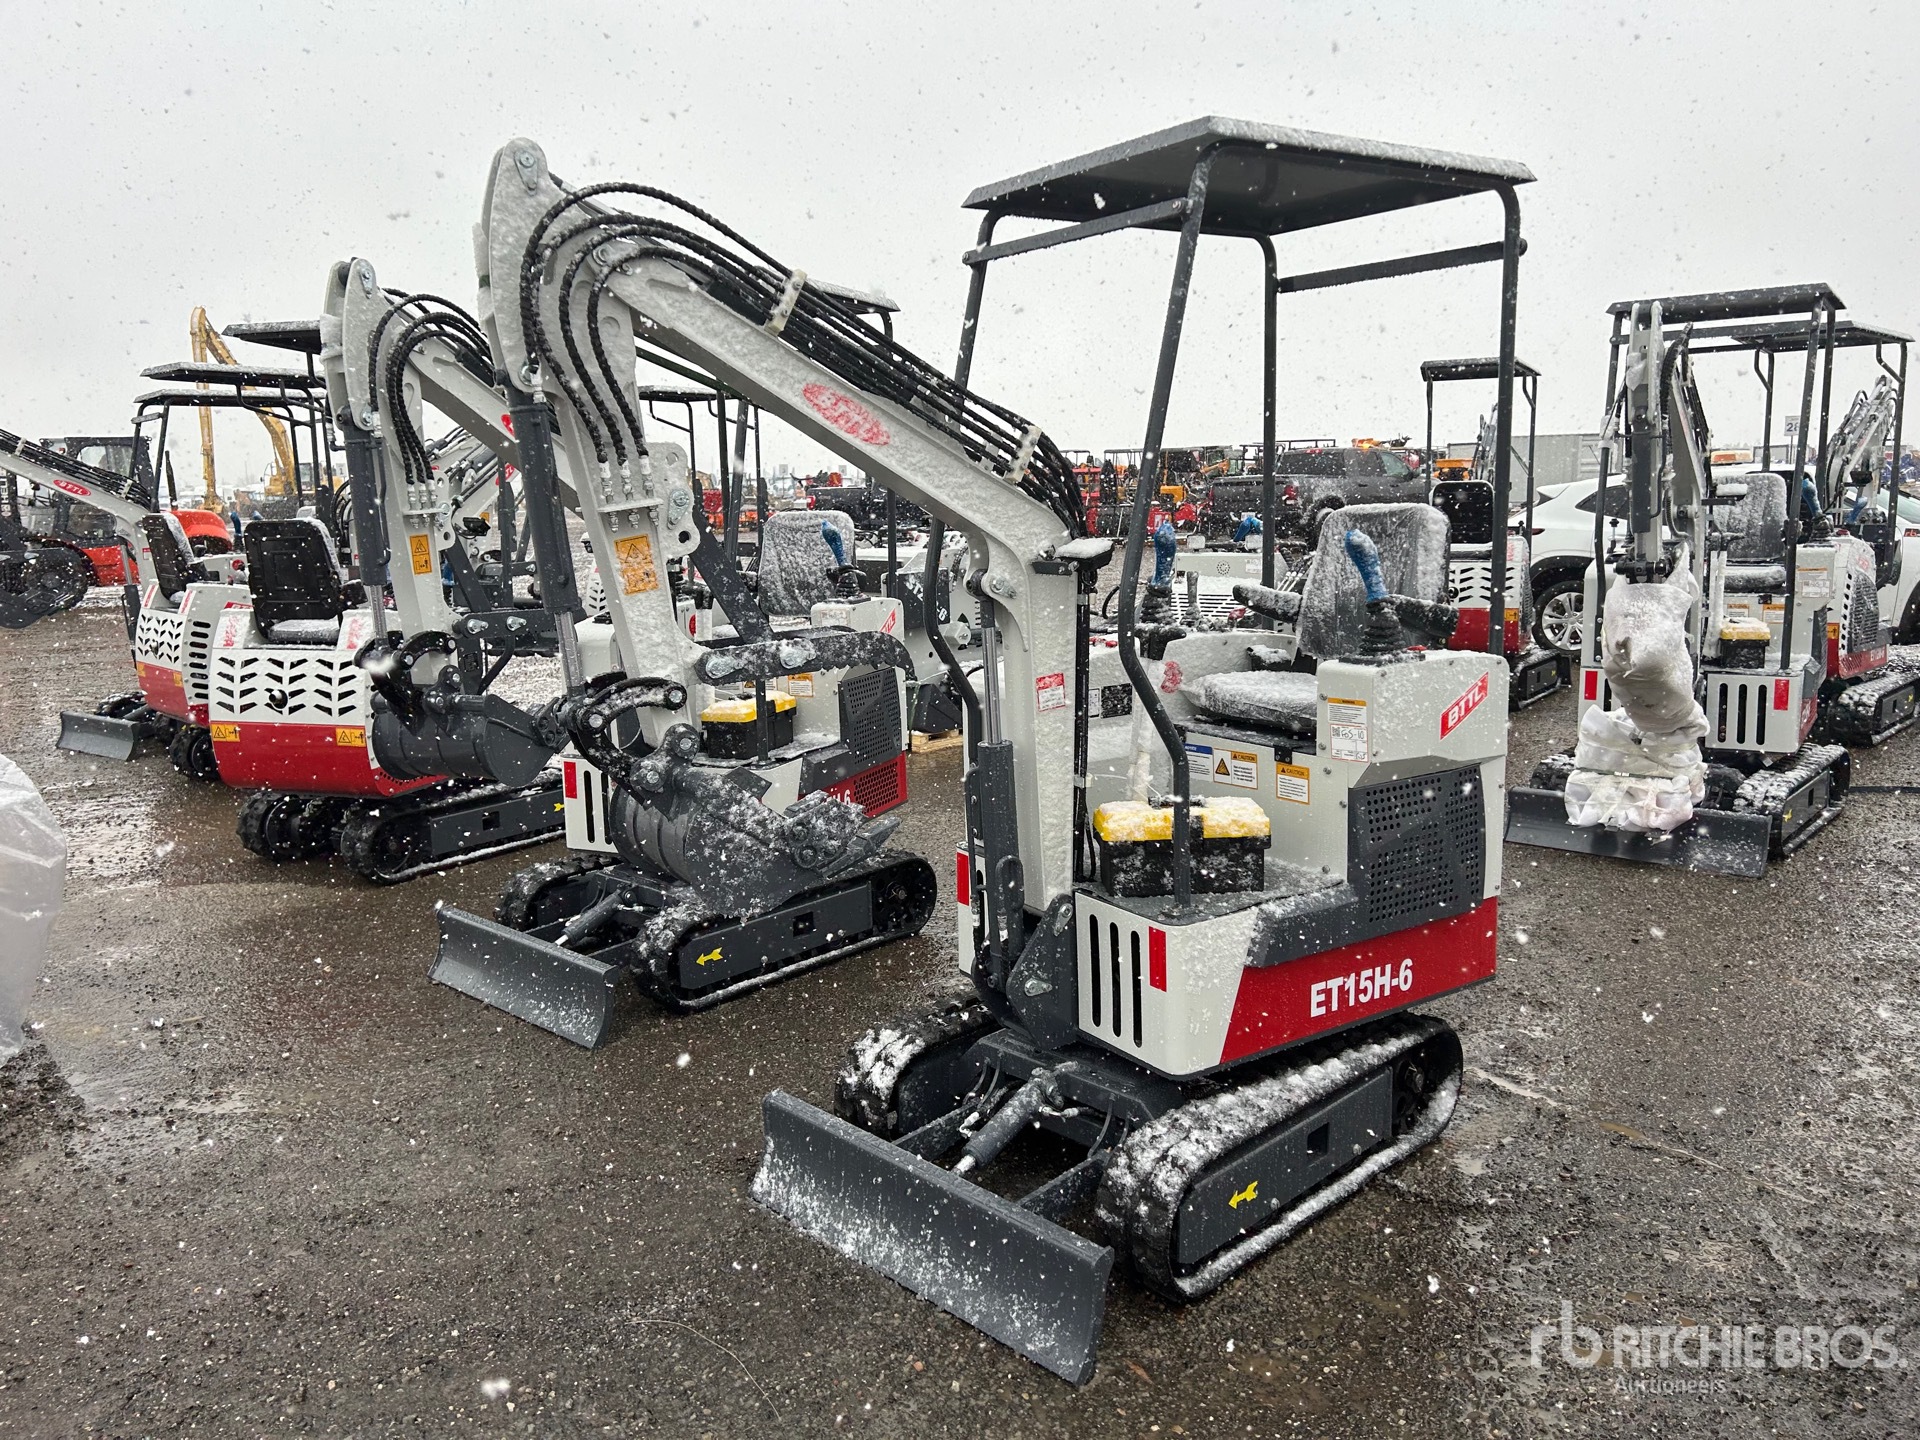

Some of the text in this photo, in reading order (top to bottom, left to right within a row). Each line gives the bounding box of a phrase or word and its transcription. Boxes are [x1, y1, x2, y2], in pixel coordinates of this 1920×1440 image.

[59, 480, 83, 495] BTTL
[1448, 686, 1485, 728] BTTL
[1286, 768, 1305, 776] CAUTION
[1310, 958, 1413, 1018] ET15H-6
